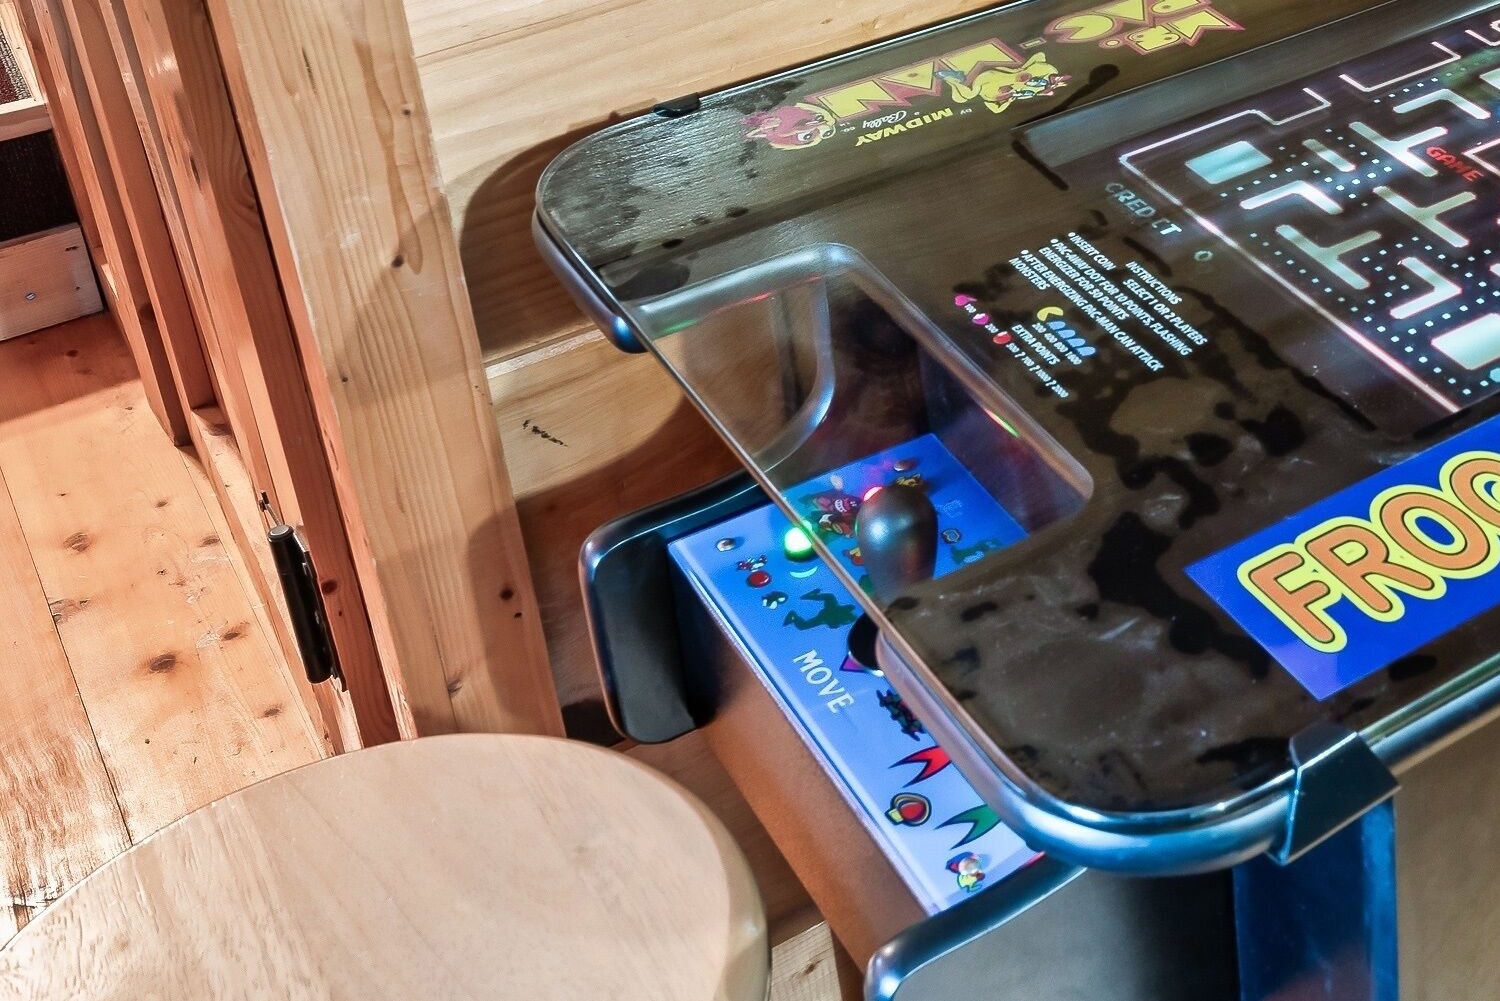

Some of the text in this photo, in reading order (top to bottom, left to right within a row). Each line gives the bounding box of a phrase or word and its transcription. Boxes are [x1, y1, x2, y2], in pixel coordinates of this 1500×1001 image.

[855, 107, 954, 147] MIDWAY
[862, 110, 907, 129] Bally
[1425, 146, 1485, 182] GAME
[1070, 234, 1117, 271] INSERT COIN
[1008, 257, 1051, 290] MONSTERS
[1038, 246, 1081, 280] ENERGIZER
[1074, 276, 1095, 291] FOR
[1097, 295, 1130, 320] POINTS
[1122, 278, 1155, 301] SELECT
[1125, 261, 1183, 305] INSTRUCTIONS
[1021, 253, 1165, 372] AFTER ENERGIZING PAC-MAN CAN ATTACK
[1084, 268, 1106, 283] DOT
[1099, 280, 1119, 295] FOR
[1114, 292, 1129, 303] 10
[1150, 322, 1193, 356] FLASHING
[1153, 303, 1171, 315] OR
[1164, 311, 1176, 320] 2
[1011, 324, 1060, 365] EXTRA POINTS
[1169, 316, 1208, 345] PLAYERS
[792, 649, 855, 714] MOVE
